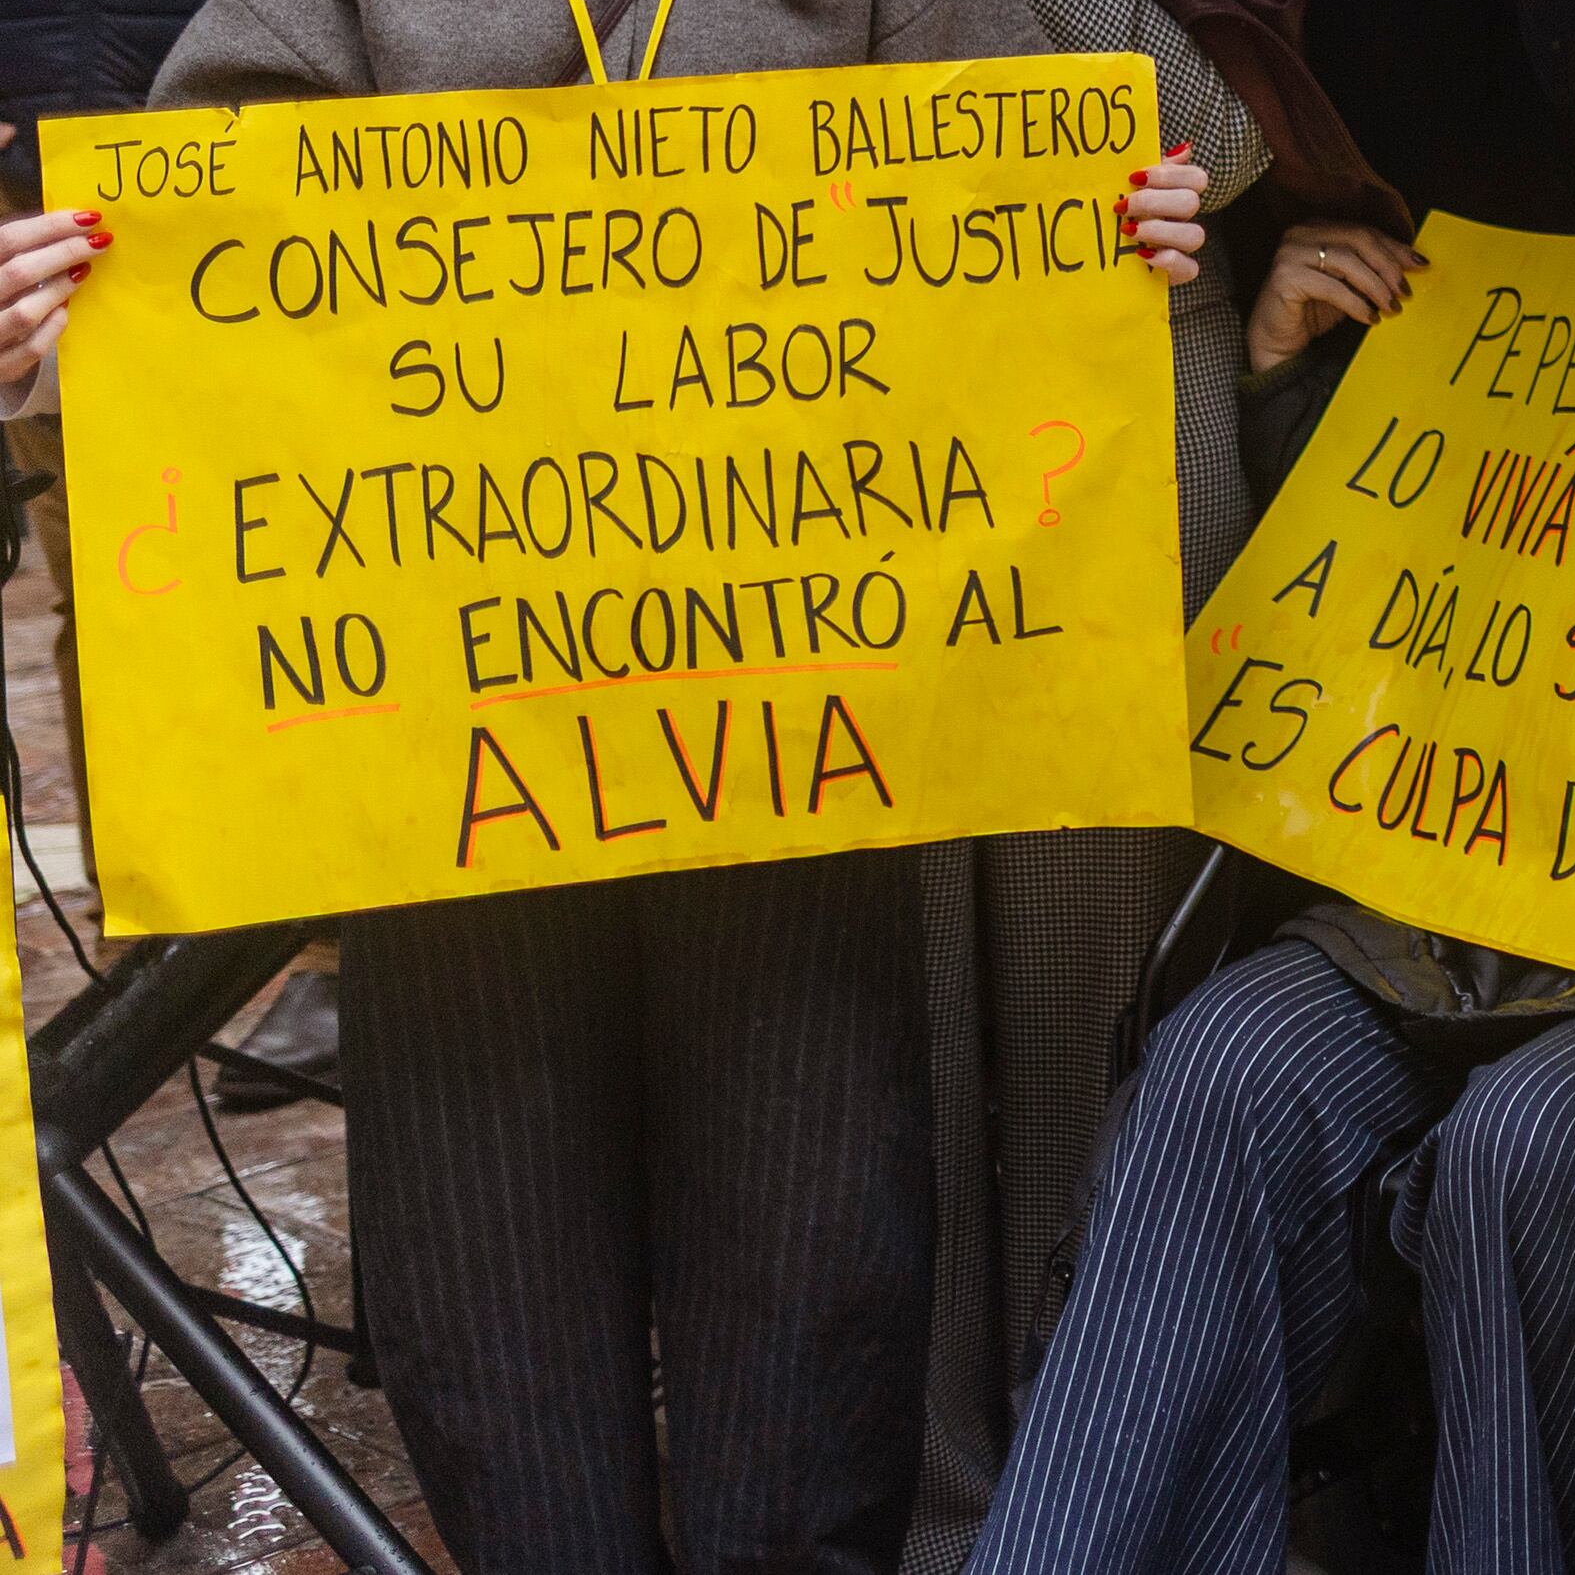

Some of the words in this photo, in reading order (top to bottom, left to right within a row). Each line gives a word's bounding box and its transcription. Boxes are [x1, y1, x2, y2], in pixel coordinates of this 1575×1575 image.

[94, 118, 236, 202] JOSÉ
[295, 116, 529, 198] ANTONIO
[590, 103, 758, 180] NIETO
[808, 84, 1137, 177] BALLESTEROS
[190, 206, 704, 324] CONSEJERO
[754, 198, 828, 292] DE
[389, 337, 506, 419] SU
[613, 318, 892, 414] LABOR
[234, 436, 996, 585] EXTRAORDINARIA
[1028, 420, 1087, 529] ?
[1345, 416, 1446, 510] LO
[256, 612, 388, 711] NO
[458, 550, 906, 695] ENCONTRÓ
[945, 564, 1066, 648] AL
[1271, 539, 1339, 619] A
[455, 693, 898, 869] ALVIA
[1328, 723, 1512, 868] CULPA
